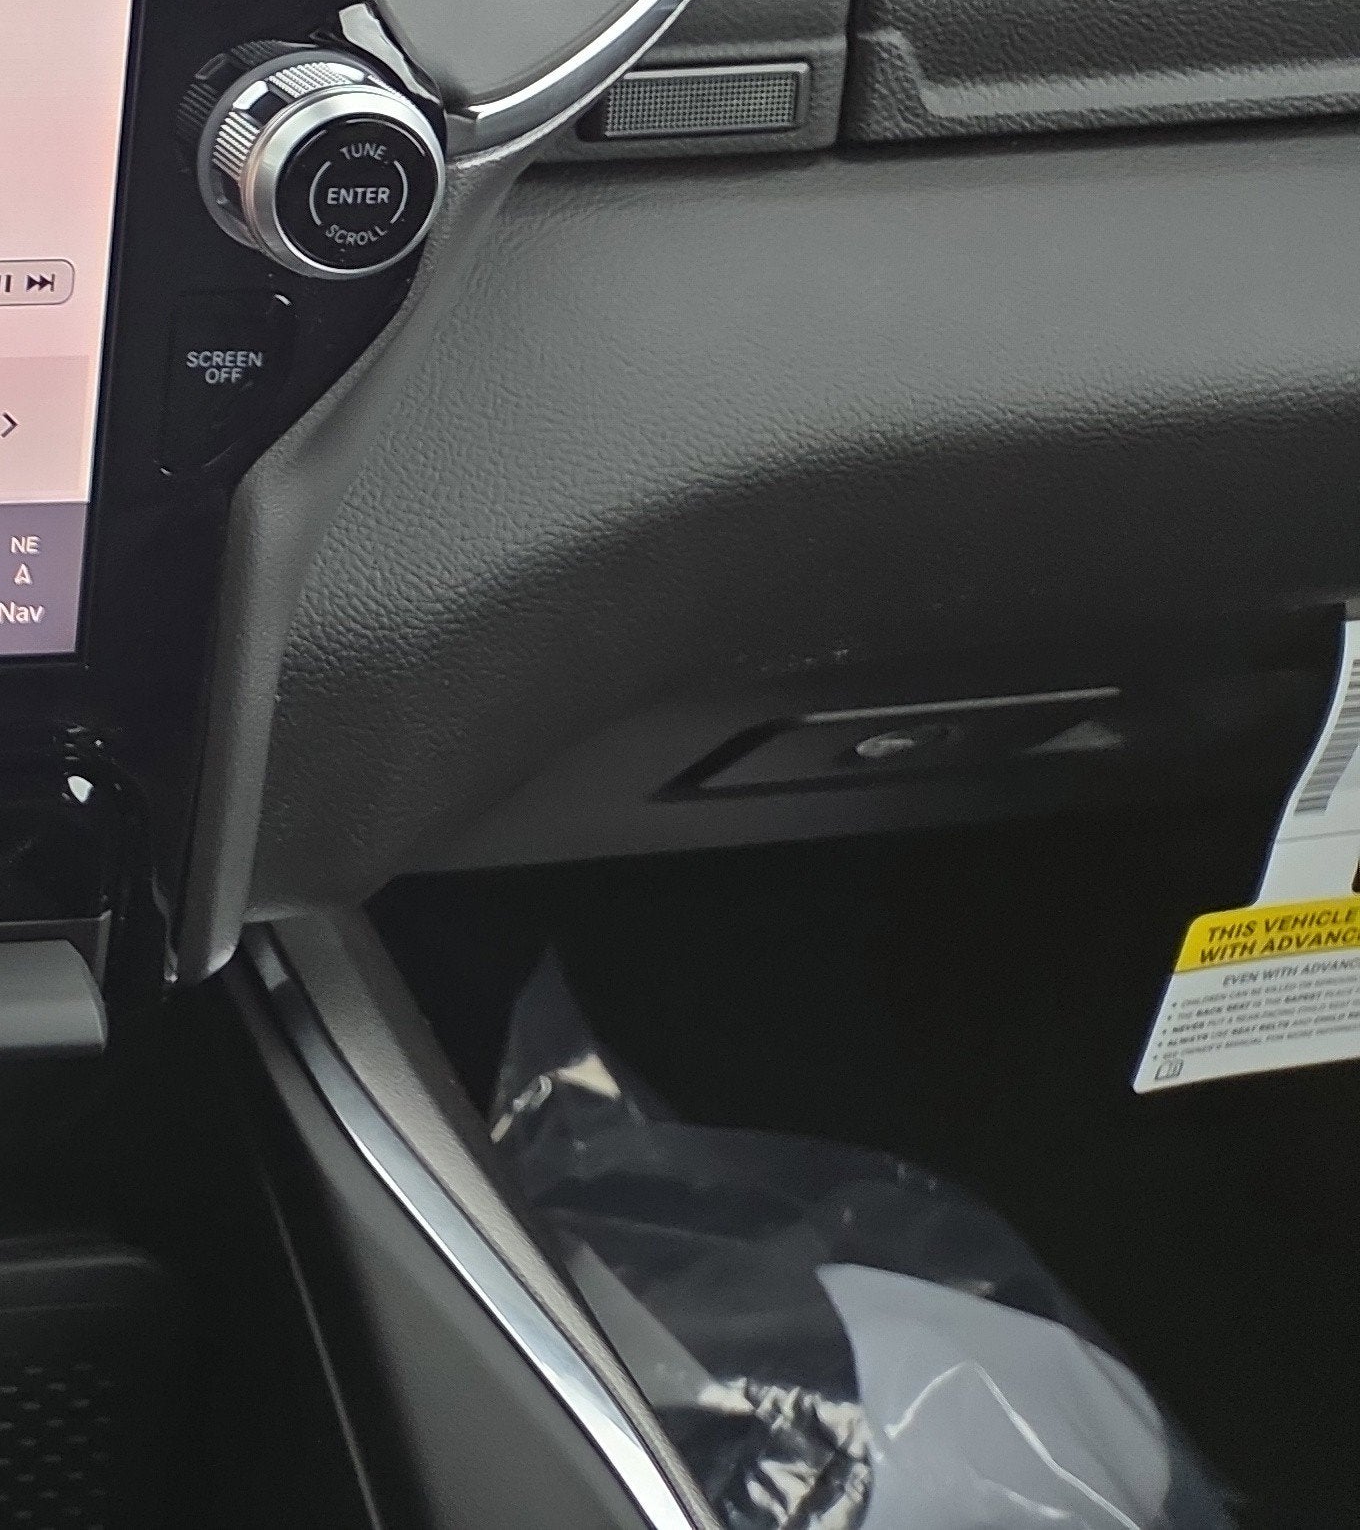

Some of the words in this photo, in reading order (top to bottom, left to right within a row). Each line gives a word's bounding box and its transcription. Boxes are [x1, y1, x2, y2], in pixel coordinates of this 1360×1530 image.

[340, 142, 386, 163] TUNE
[326, 186, 390, 206] ENTER
[325, 222, 388, 247] SCROLL
[186, 350, 263, 368] SCREEN
[204, 367, 243, 385] OFF
[10, 535, 40, 554] NE
[1208, 920, 1257, 943] THIS
[1263, 908, 1358, 934] VEHICLE
[1200, 939, 1257, 964] WITH
[1260, 926, 1360, 954] ADVANC
[1262, 965, 1299, 981] WITH
